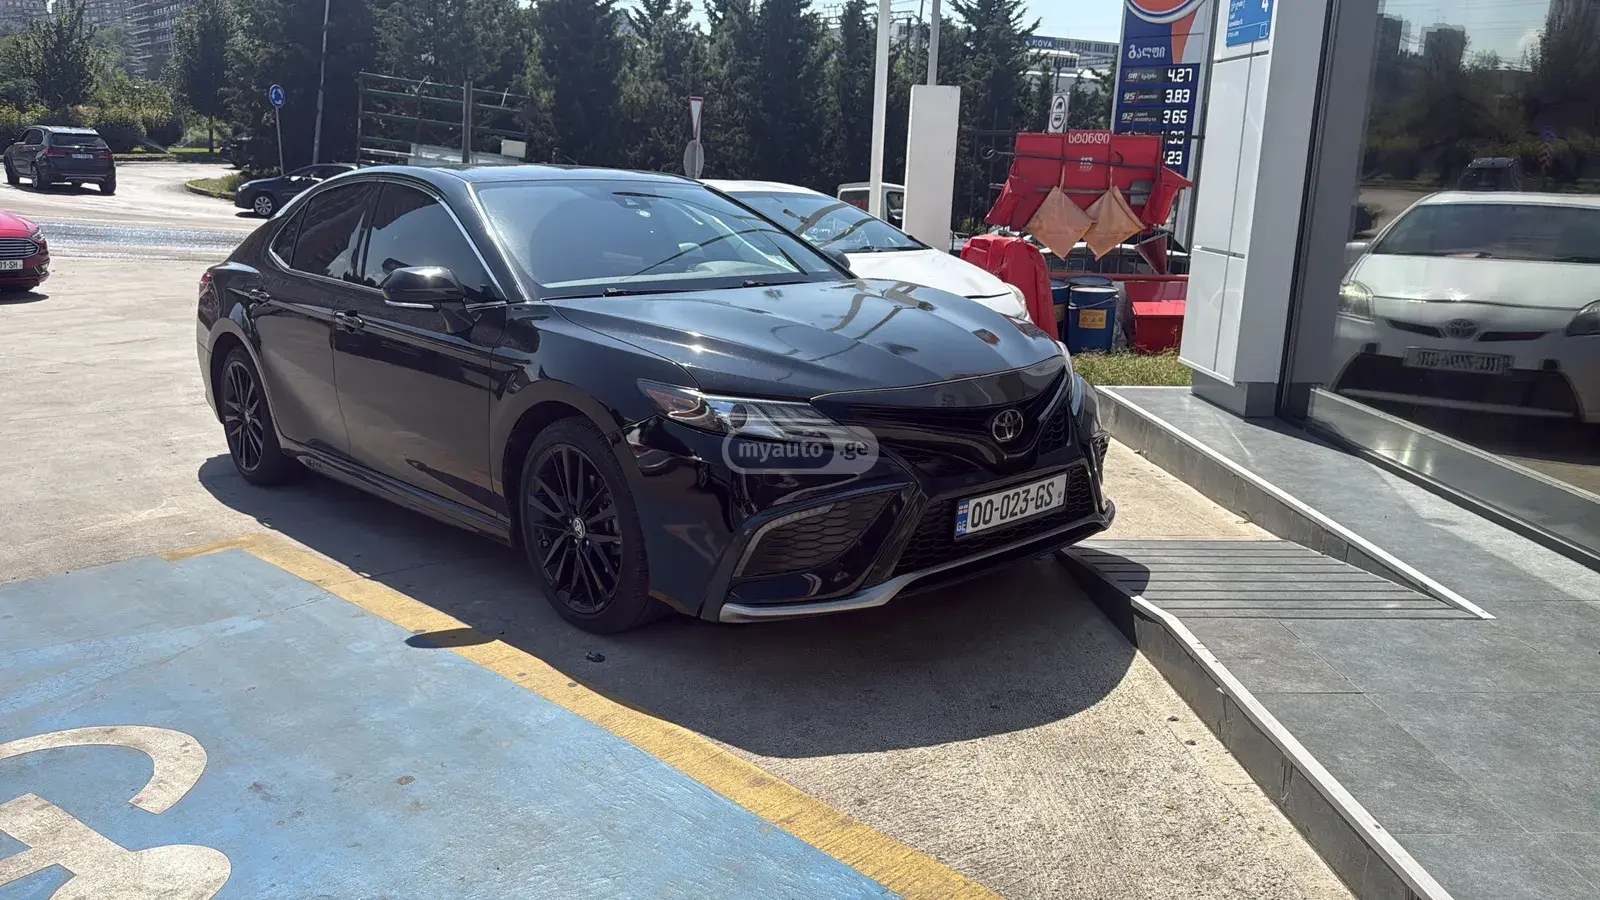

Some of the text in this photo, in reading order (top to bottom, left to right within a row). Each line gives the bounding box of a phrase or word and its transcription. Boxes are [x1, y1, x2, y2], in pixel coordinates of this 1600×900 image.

[1128, 44, 1166, 59] გალფი
[1167, 68, 1193, 82] 4.27
[1123, 92, 1136, 100] 95
[1165, 89, 1190, 103] 3.83
[1121, 112, 1134, 120] 92
[1068, 132, 1110, 144] სტენდი
[956, 519, 967, 533] GE
